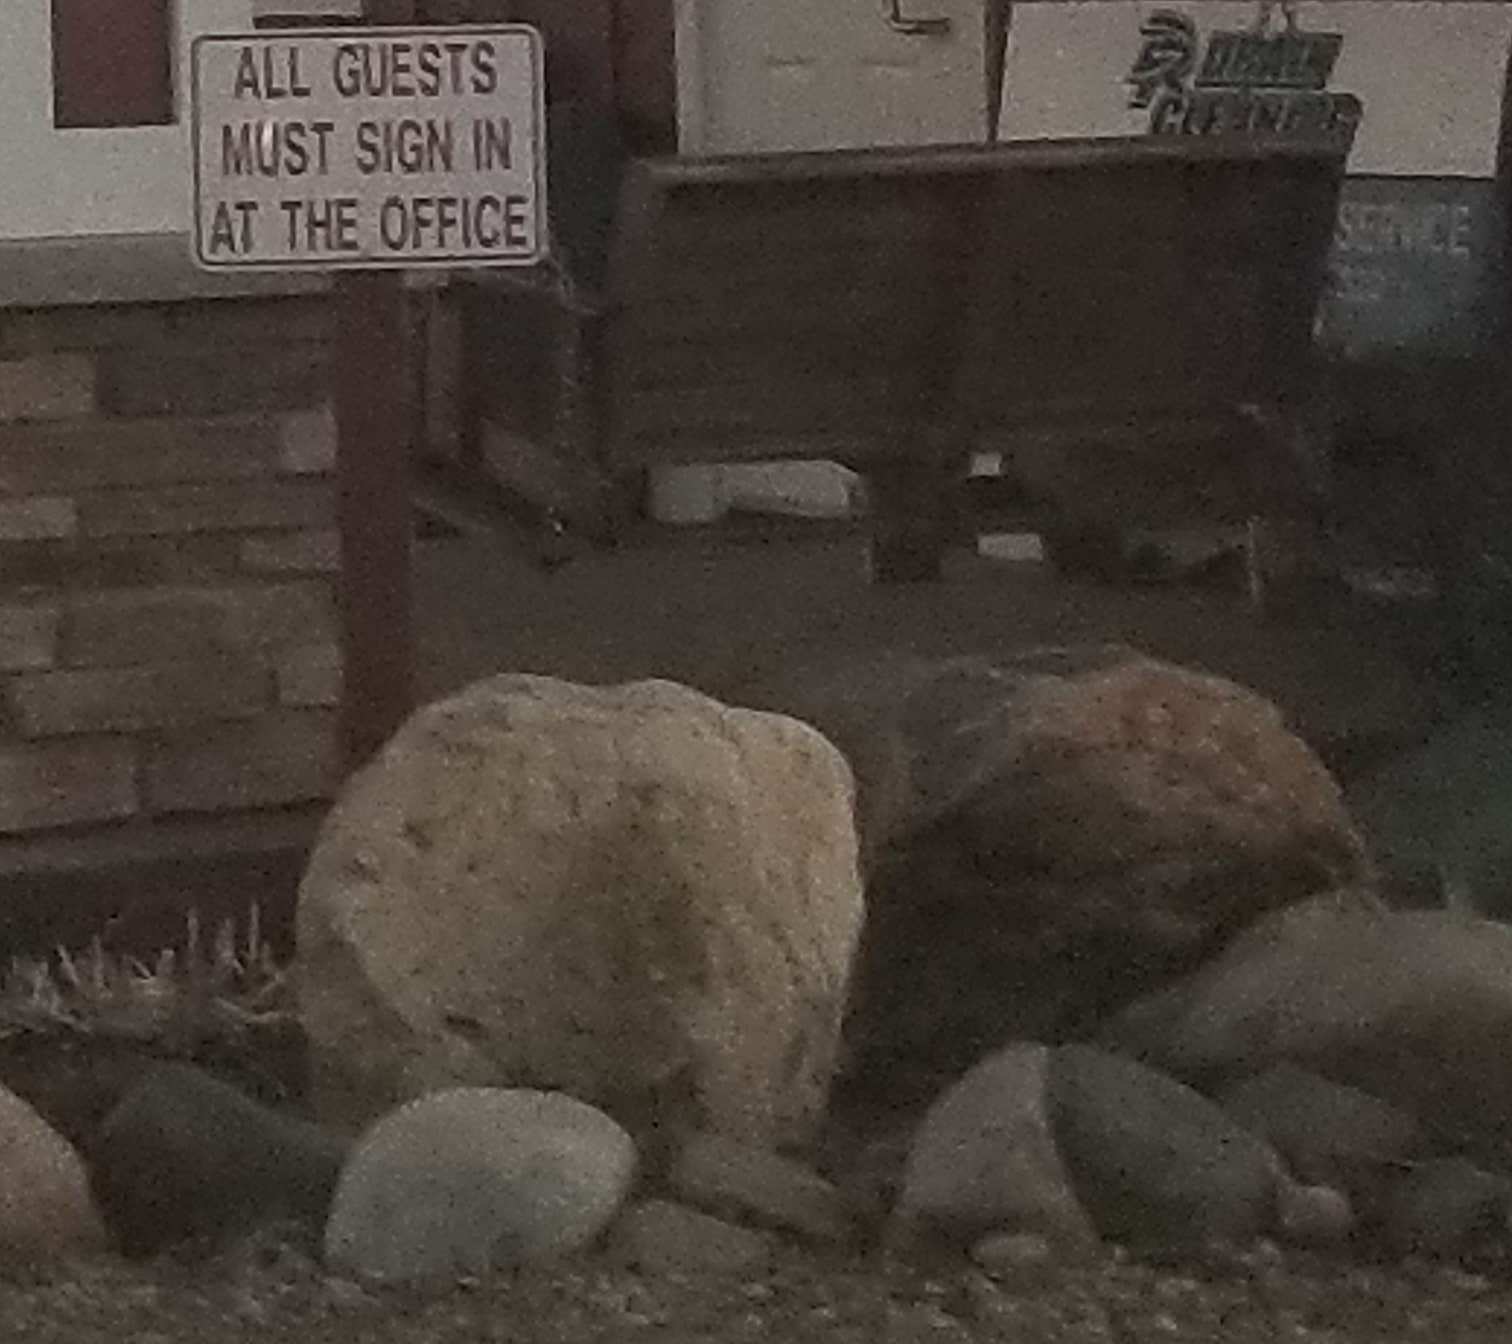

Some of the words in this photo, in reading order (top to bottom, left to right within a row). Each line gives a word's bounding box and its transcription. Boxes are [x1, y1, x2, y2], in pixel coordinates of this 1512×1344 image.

[234, 45, 311, 100] ALL
[333, 41, 498, 97] GUESTS
[222, 121, 334, 176] MUST
[355, 118, 453, 175] SIGN
[473, 116, 512, 171] IN
[208, 199, 259, 255] AT
[280, 197, 358, 252] THE
[379, 194, 528, 251] OFFICE
